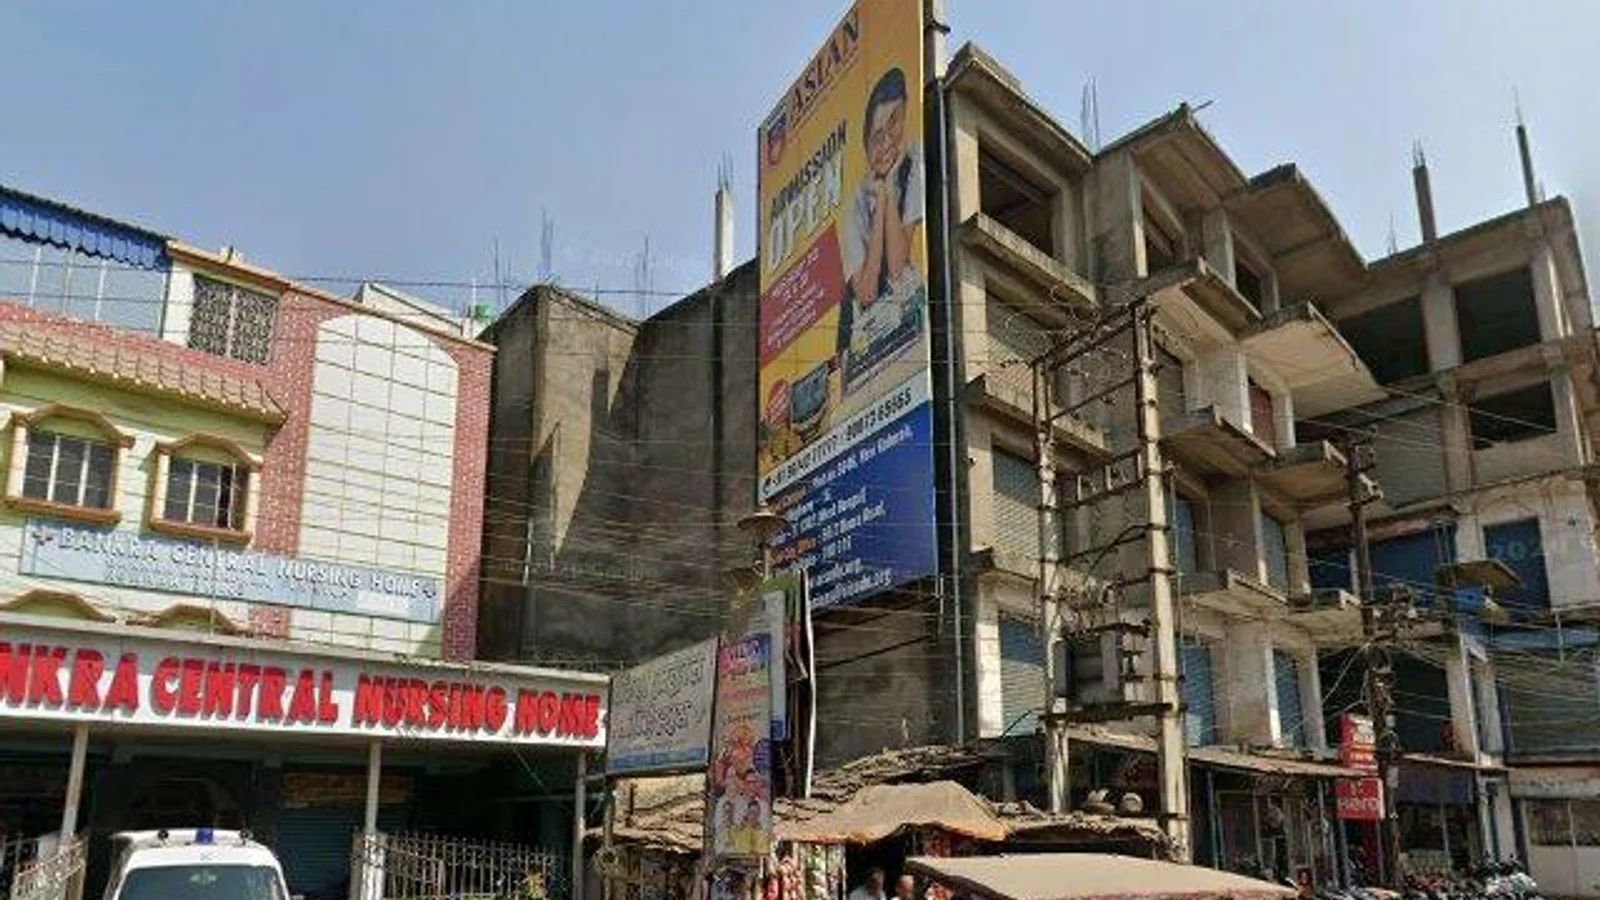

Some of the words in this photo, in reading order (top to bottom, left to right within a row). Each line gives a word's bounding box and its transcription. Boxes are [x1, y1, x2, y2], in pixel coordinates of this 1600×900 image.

[790, 11, 860, 124] ASIAN
[768, 151, 843, 271] OPEN
[770, 119, 846, 222] ADMISSION
[171, 541, 267, 578] CENTRAL
[277, 559, 361, 589] NURSING
[369, 572, 420, 599] HOME
[151, 655, 339, 725] CENTRAL
[352, 673, 507, 734] NURSING
[516, 687, 601, 740] HOME
